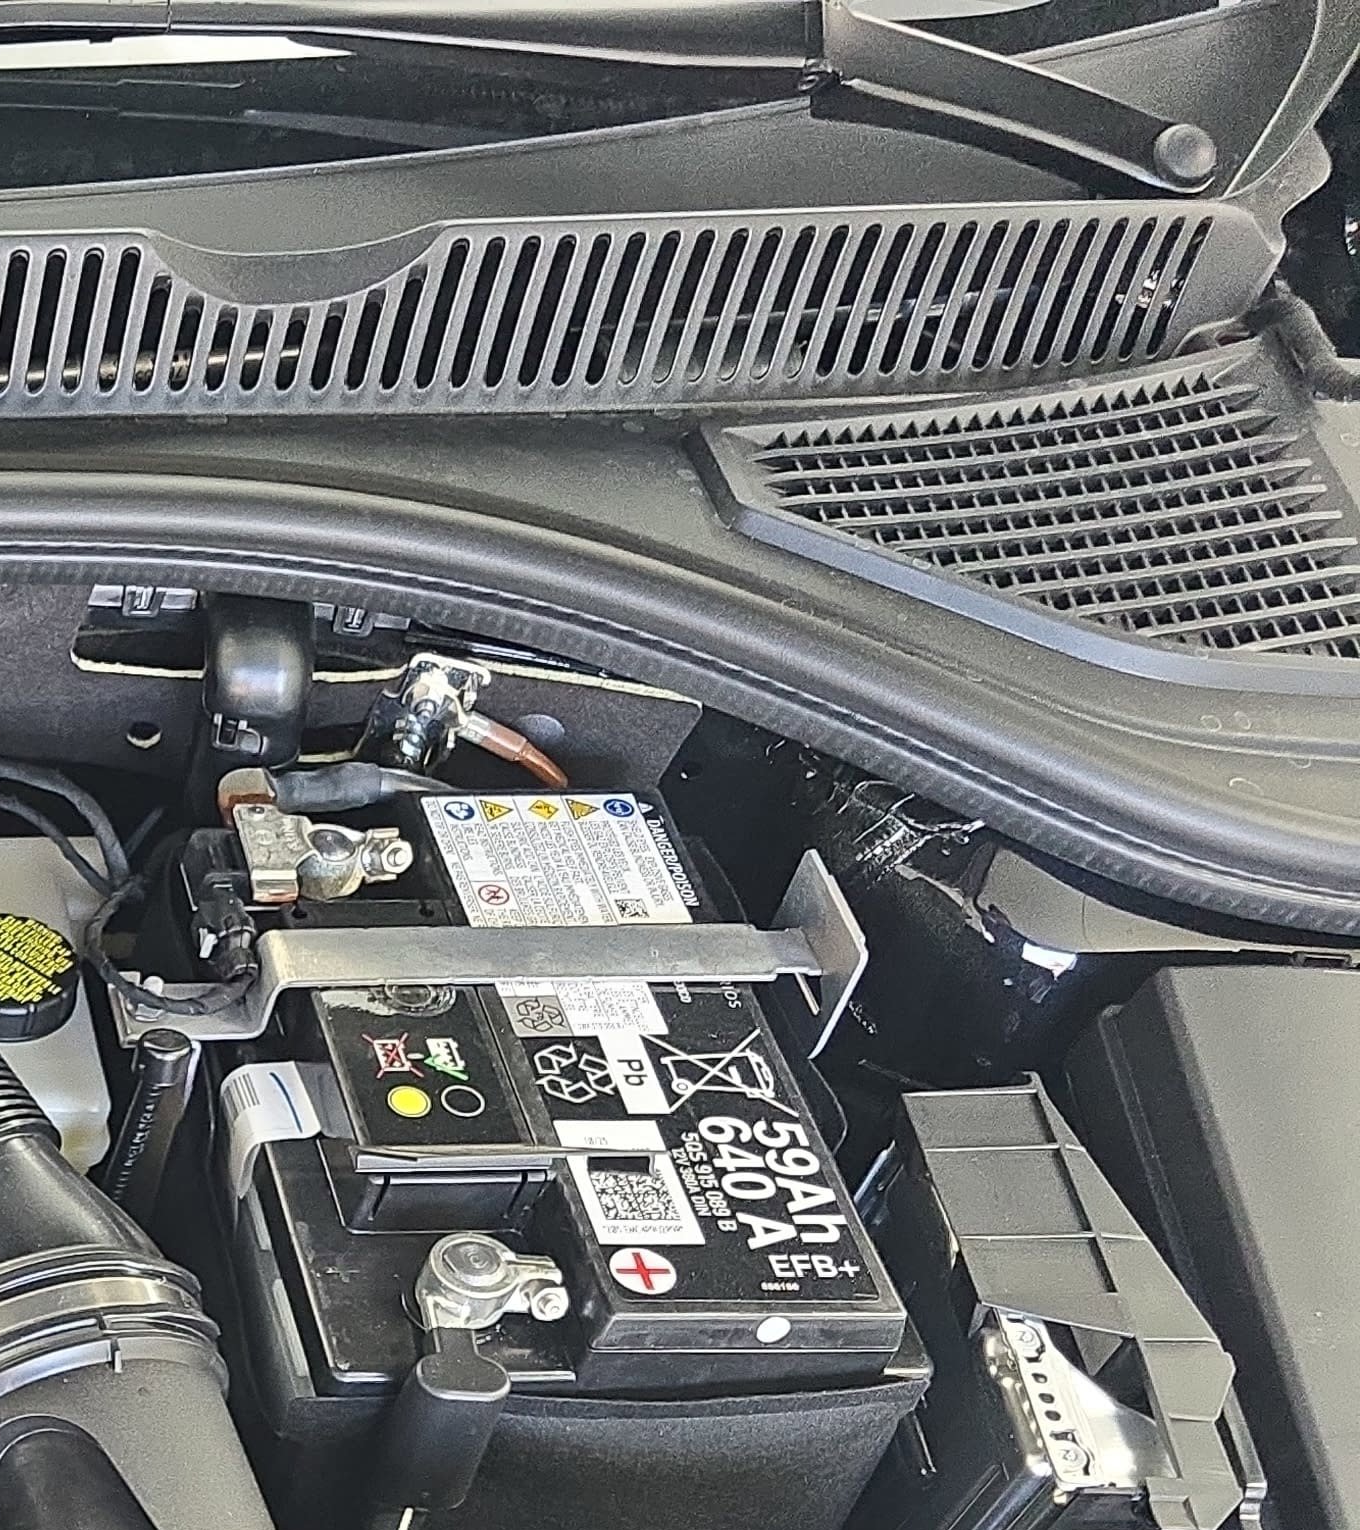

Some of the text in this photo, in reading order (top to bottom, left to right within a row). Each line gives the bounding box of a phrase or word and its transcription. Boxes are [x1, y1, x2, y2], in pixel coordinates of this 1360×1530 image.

[646, 818, 700, 907] DANGER/POISON
[617, 1058, 648, 1087] Pb
[671, 1147, 691, 1169] 12V
[690, 1195, 713, 1218] DIN
[694, 1163, 720, 1189] 915
[698, 1116, 799, 1251] 640 A
[753, 1120, 848, 1244] 59Ah
[705, 1190, 732, 1217] 089
[716, 1218, 739, 1233] B
[768, 1253, 860, 1278] EFB+
